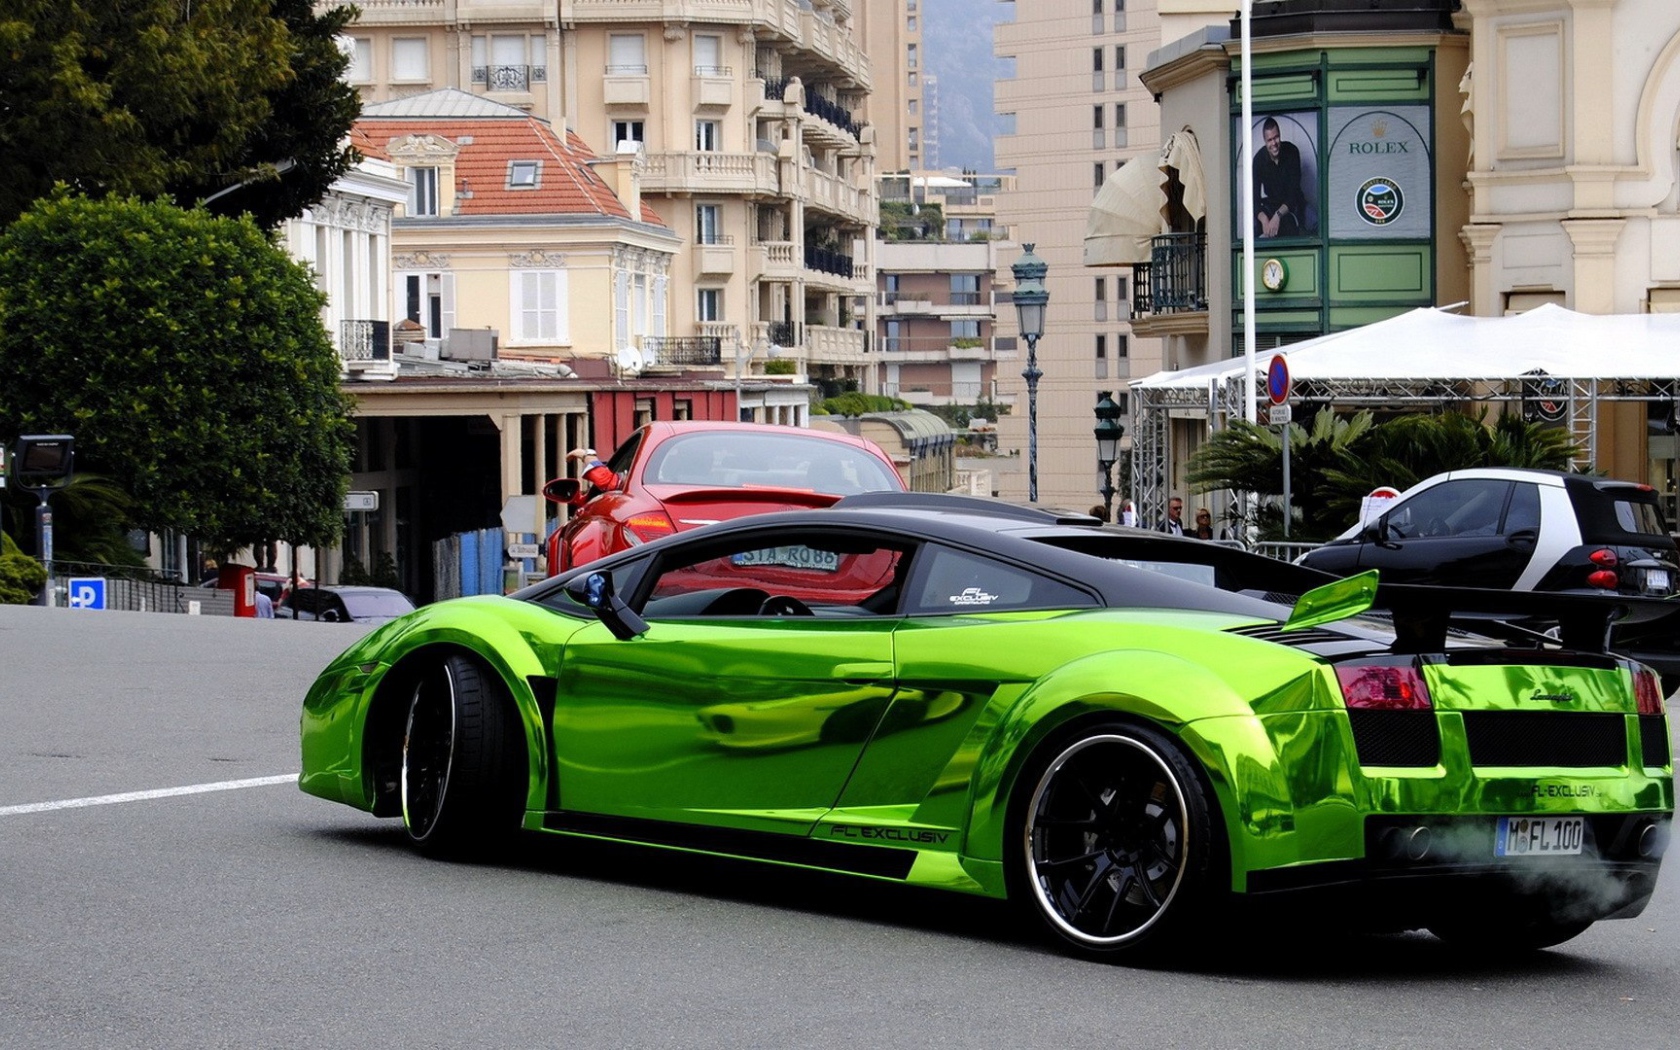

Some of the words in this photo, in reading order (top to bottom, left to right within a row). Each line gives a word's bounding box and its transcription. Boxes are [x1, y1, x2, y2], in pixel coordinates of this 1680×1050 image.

[1349, 141, 1408, 154] ROLEX
[830, 824, 857, 837] FL
[861, 828, 949, 844] EXCLUSIV
